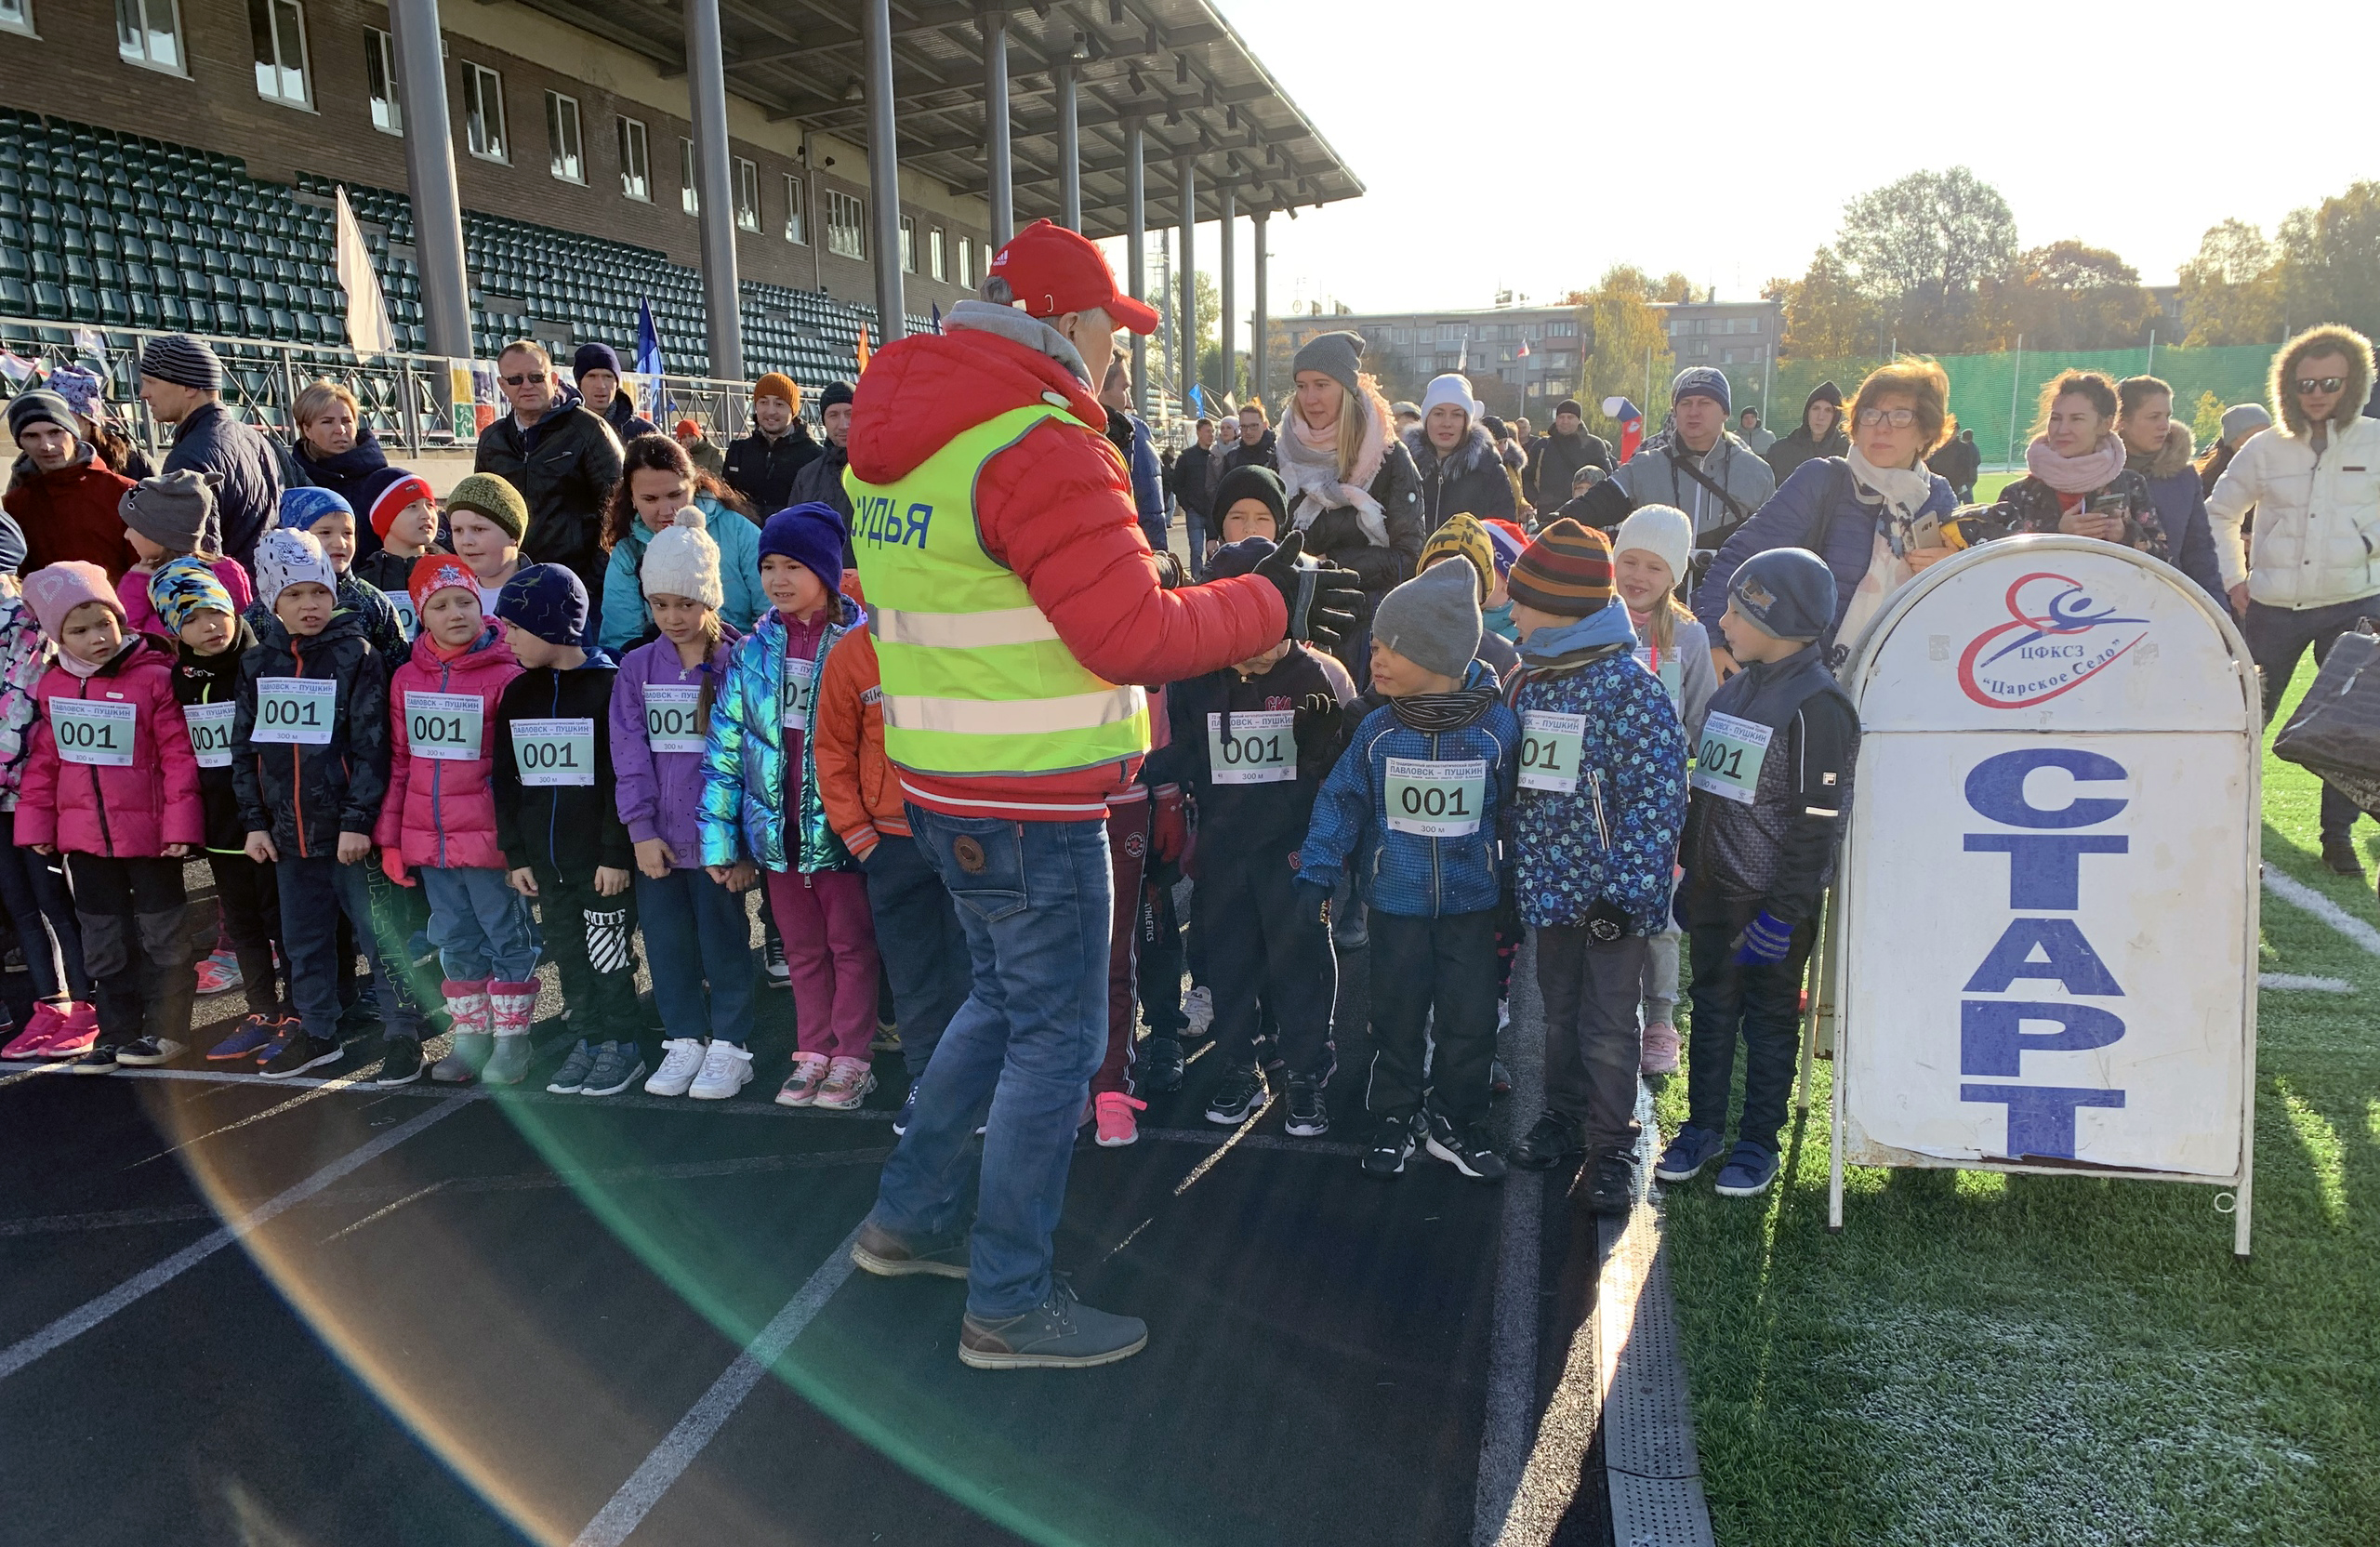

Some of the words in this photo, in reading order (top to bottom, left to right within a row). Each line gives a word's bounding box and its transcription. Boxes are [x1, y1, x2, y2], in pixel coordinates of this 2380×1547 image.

[2020, 644, 2084, 659] ЦФКСЗ
[52, 704, 85, 713] ПАВЛОВСК
[94, 707, 131, 717] ПУШКИН
[265, 699, 321, 726] 001
[407, 698, 436, 707] ПАВЛОВСК
[415, 715, 467, 743] 001
[649, 708, 702, 734] 001
[1542, 720, 1580, 730] ПУШКИН
[60, 721, 118, 748] 001
[192, 724, 230, 750] 001
[1734, 726, 1766, 743] ПУШКИН
[523, 742, 578, 768] 001
[1223, 734, 1284, 764] 001
[1521, 737, 1561, 770] 01
[1700, 739, 1743, 780] 001
[1390, 766, 1435, 775] ПАВЛОВСК
[1445, 767, 1483, 776] ПУШКИН
[1402, 787, 1470, 816] 001
[1144, 902, 1154, 942] ATHLETICS
[1960, 747, 2129, 1159] СТАРТ
